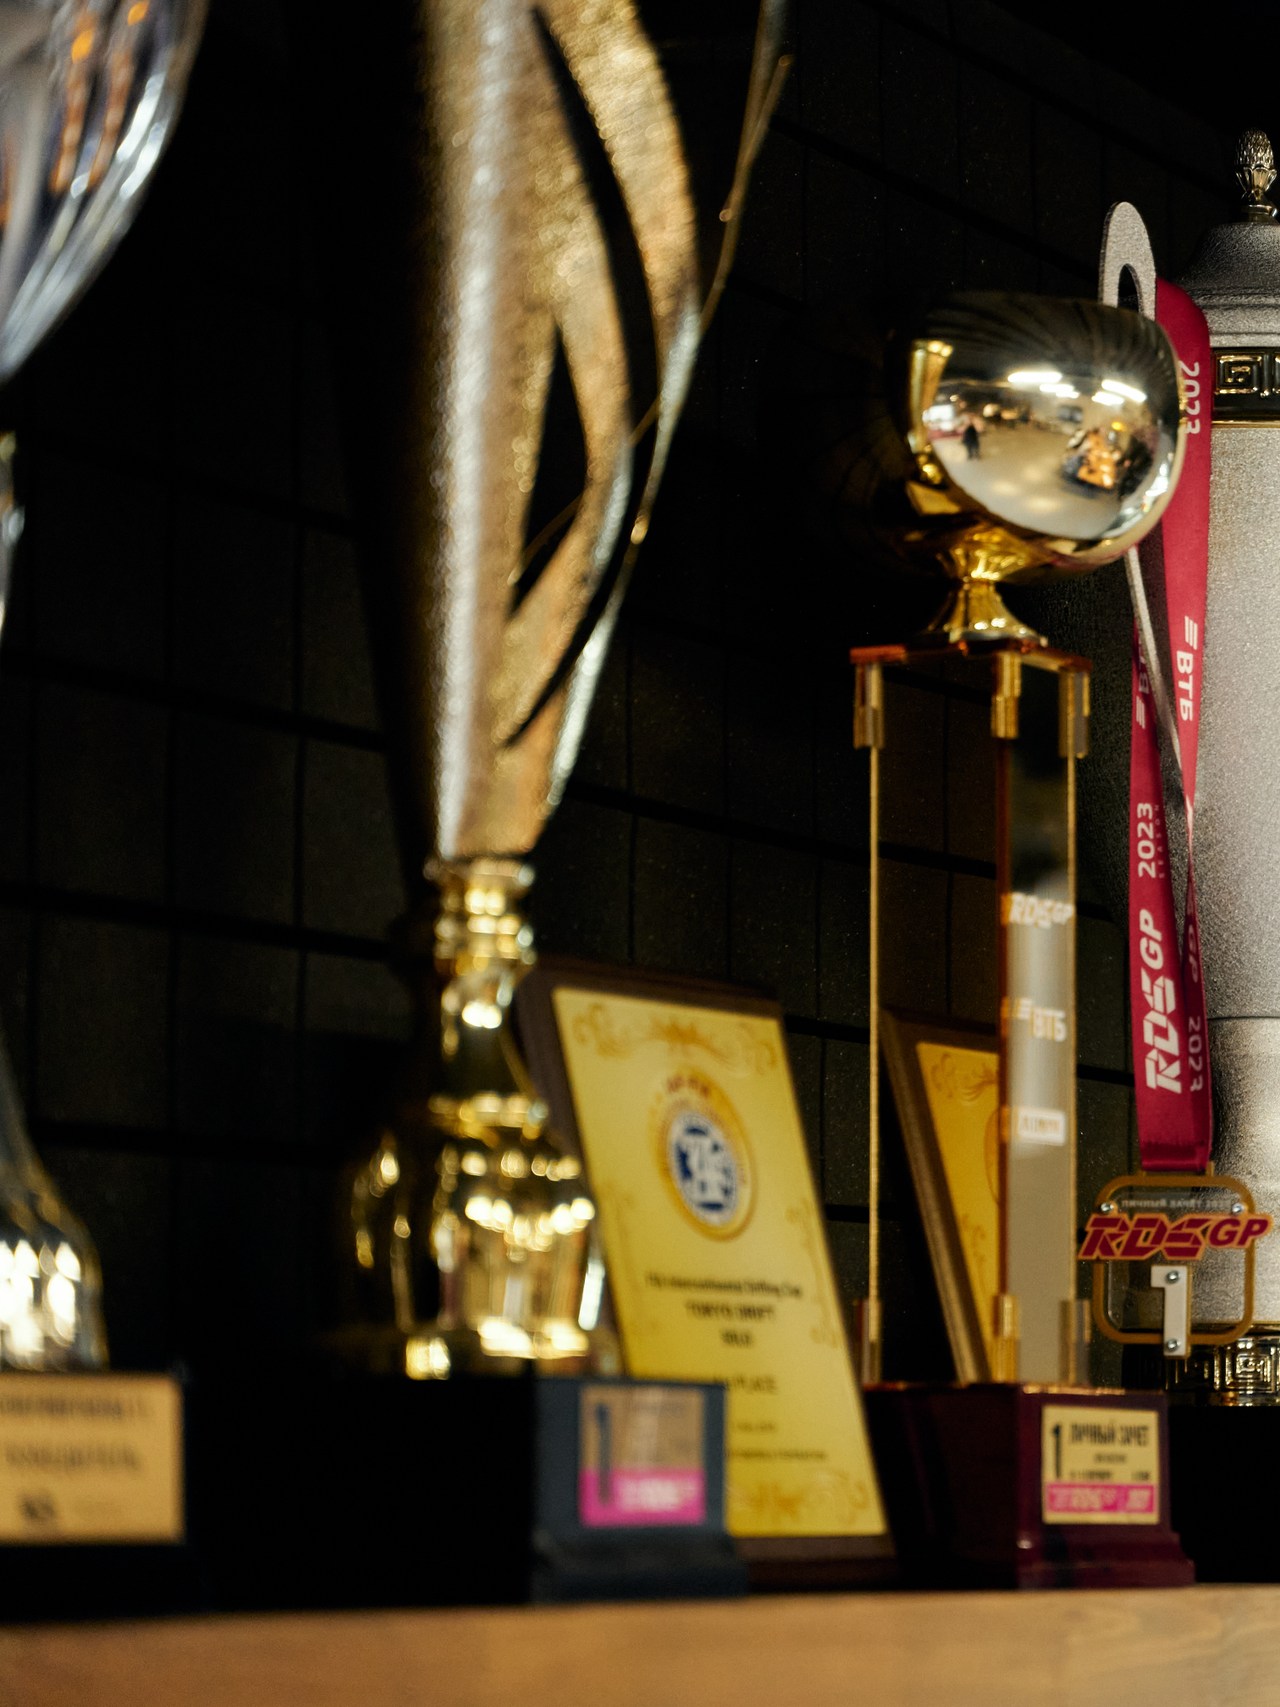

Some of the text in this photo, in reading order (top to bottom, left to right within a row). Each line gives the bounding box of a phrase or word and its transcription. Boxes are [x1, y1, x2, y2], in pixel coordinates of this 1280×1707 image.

[1176, 650, 1194, 722] ВТБ
[1136, 802, 1157, 879] 2023
[1154, 804, 1166, 879] SEASON
[1138, 907, 1182, 1095] RDS GP
[1188, 1015, 1204, 1093] 2023
[1078, 1215, 1271, 1260] RDS GP
[1150, 1265, 1188, 1357] 1
[1052, 1423, 1063, 1480] 1
